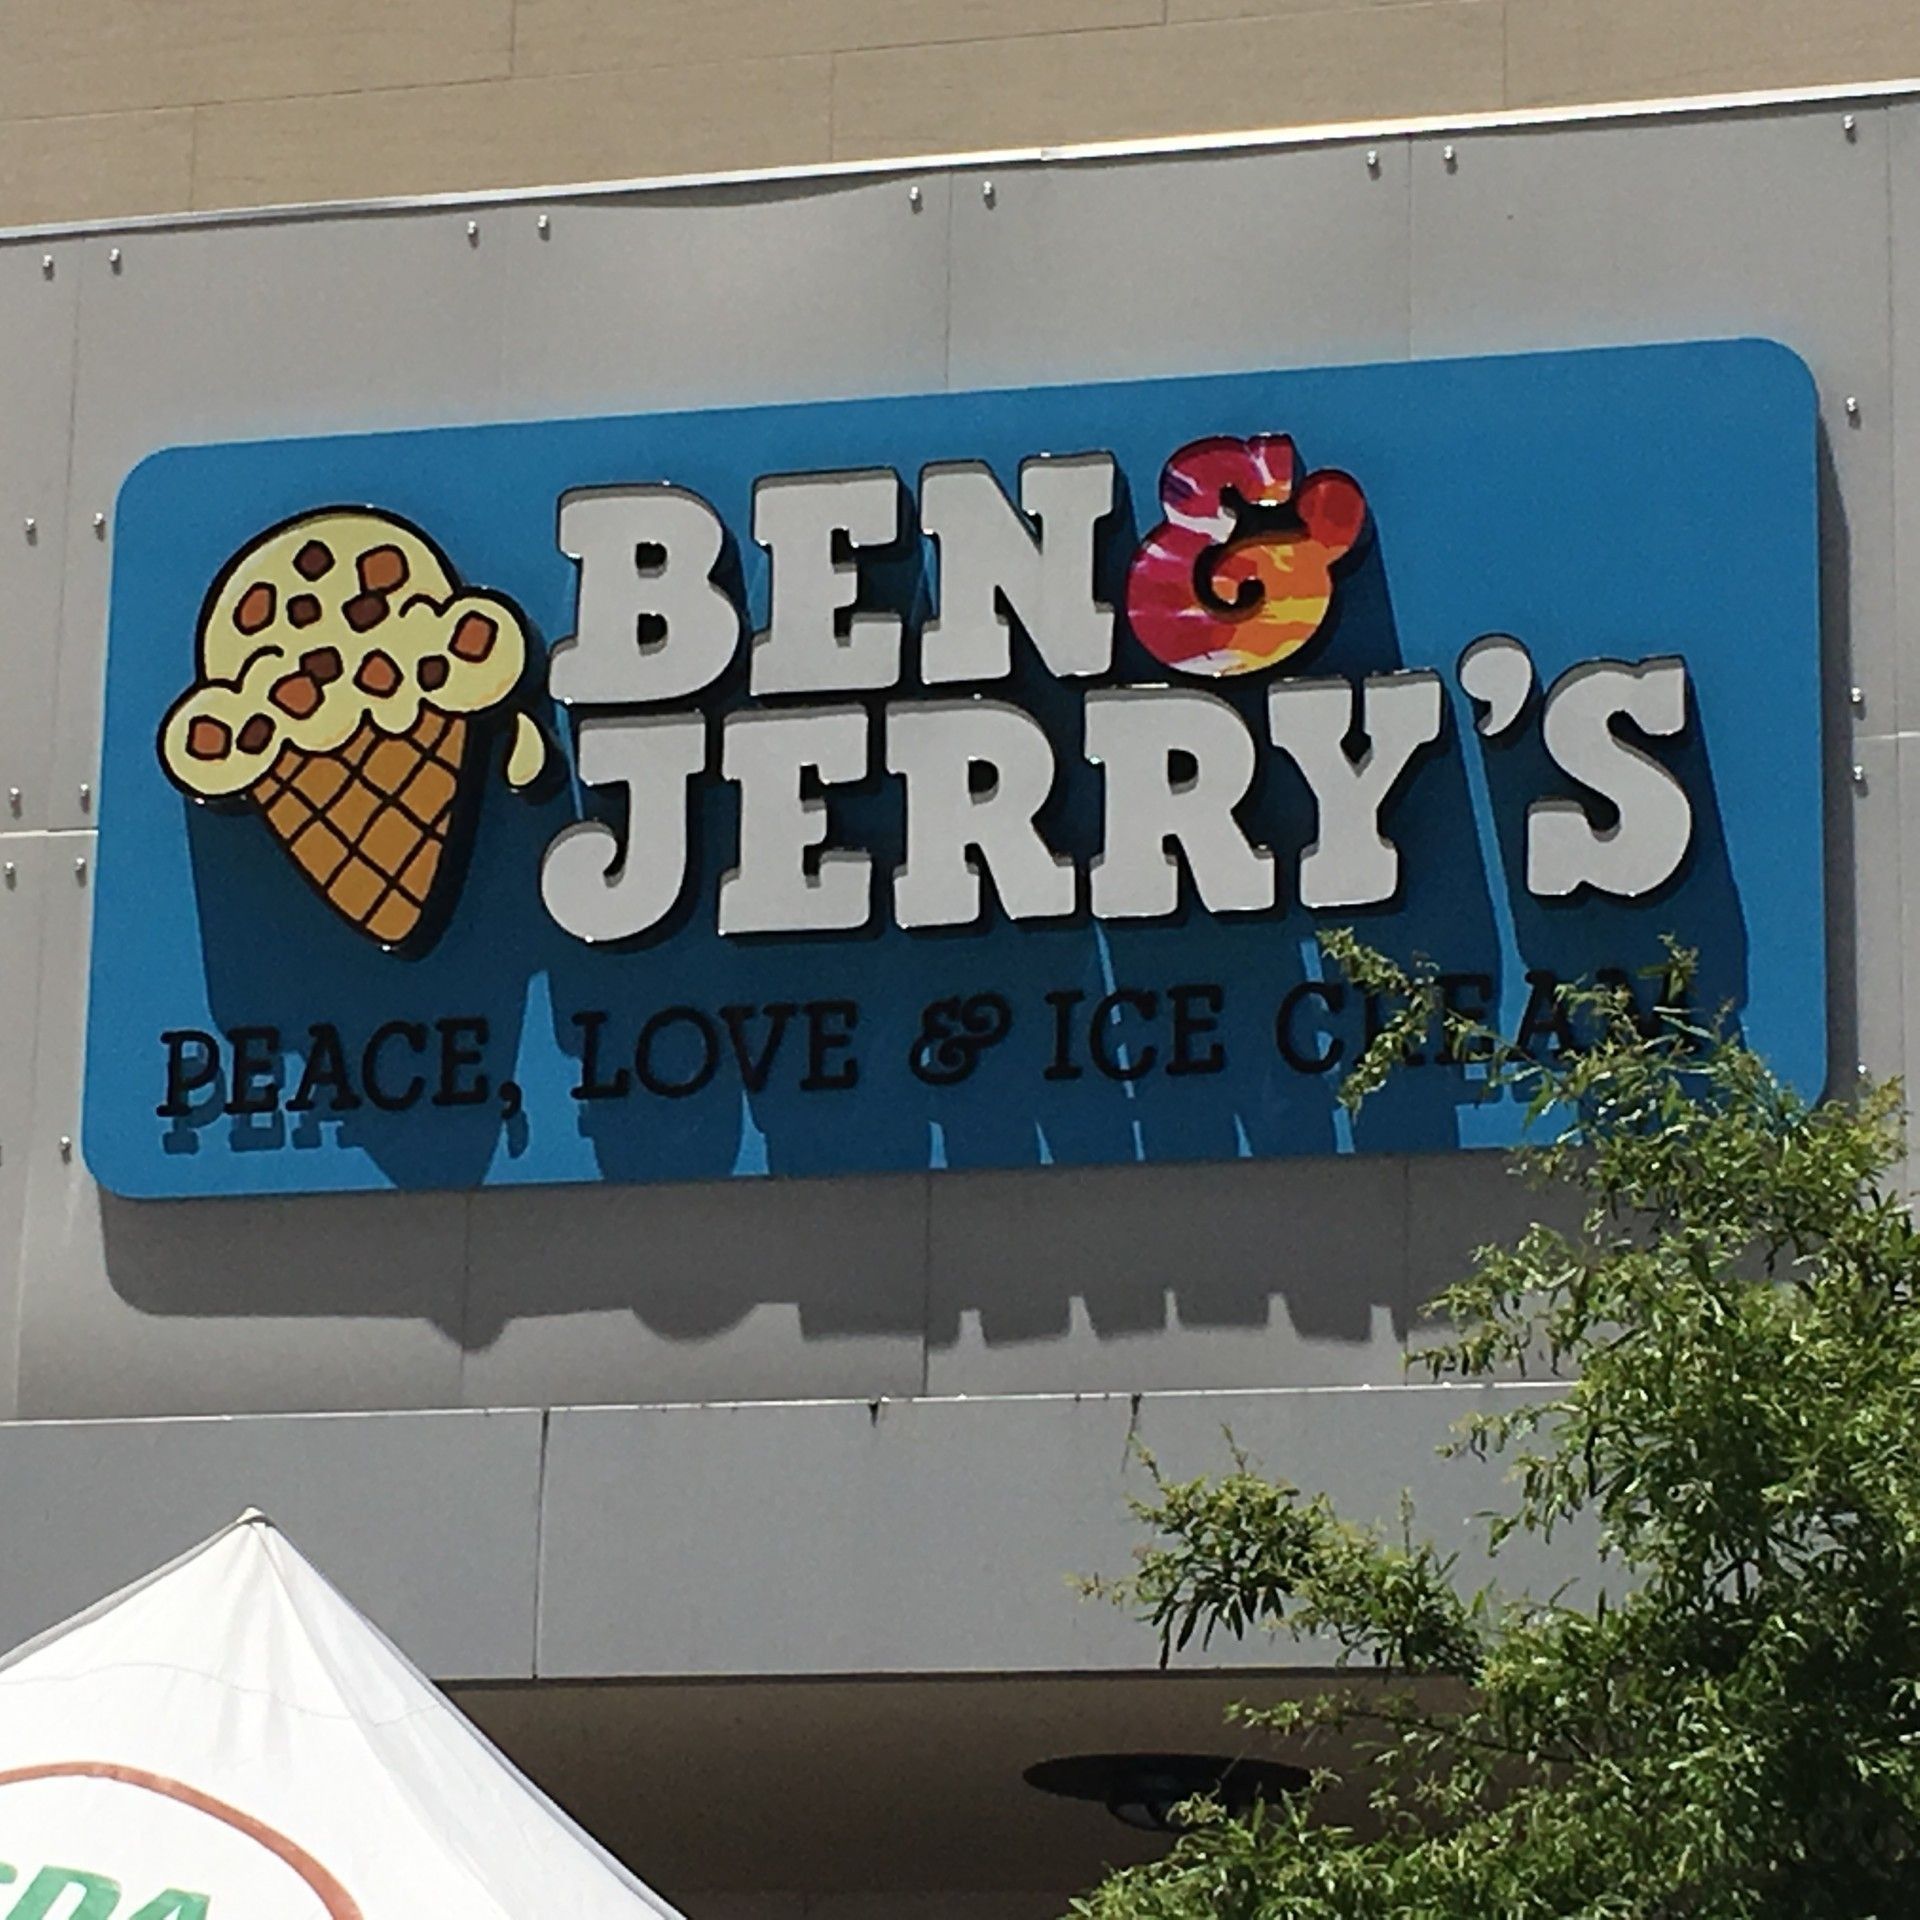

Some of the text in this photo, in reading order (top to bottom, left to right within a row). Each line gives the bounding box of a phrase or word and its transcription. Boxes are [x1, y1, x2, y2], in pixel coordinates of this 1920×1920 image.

[549, 431, 1367, 704] BEN &
[540, 631, 1694, 943] JERRY'S
[156, 1016, 523, 1120] PEACE,
[570, 999, 859, 1100] LOVE
[908, 991, 1013, 1086] &
[1042, 984, 1225, 1082] ICE
